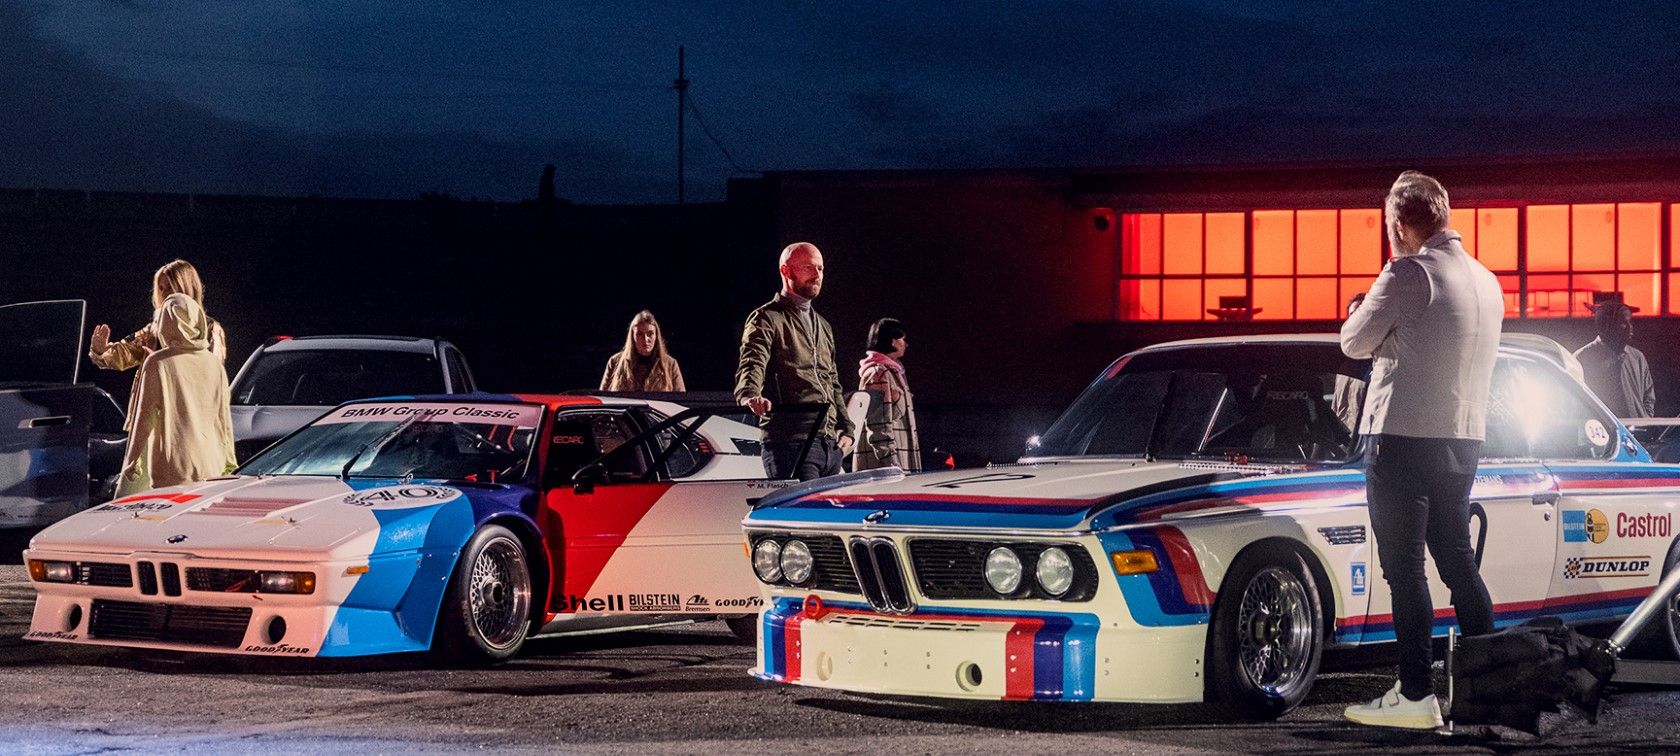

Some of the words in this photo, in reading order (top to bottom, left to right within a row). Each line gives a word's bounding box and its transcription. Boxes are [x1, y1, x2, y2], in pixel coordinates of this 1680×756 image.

[341, 406, 392, 418] BMW
[392, 406, 448, 417] Group
[453, 406, 520, 419] Classic
[1616, 512, 1671, 538] Castrol
[1582, 561, 1649, 573] DUNLOP
[553, 594, 624, 611] Shell
[629, 594, 680, 605] BILSTEIN
[715, 597, 764, 608] GOODY
[245, 644, 309, 654] GOODYEAR
